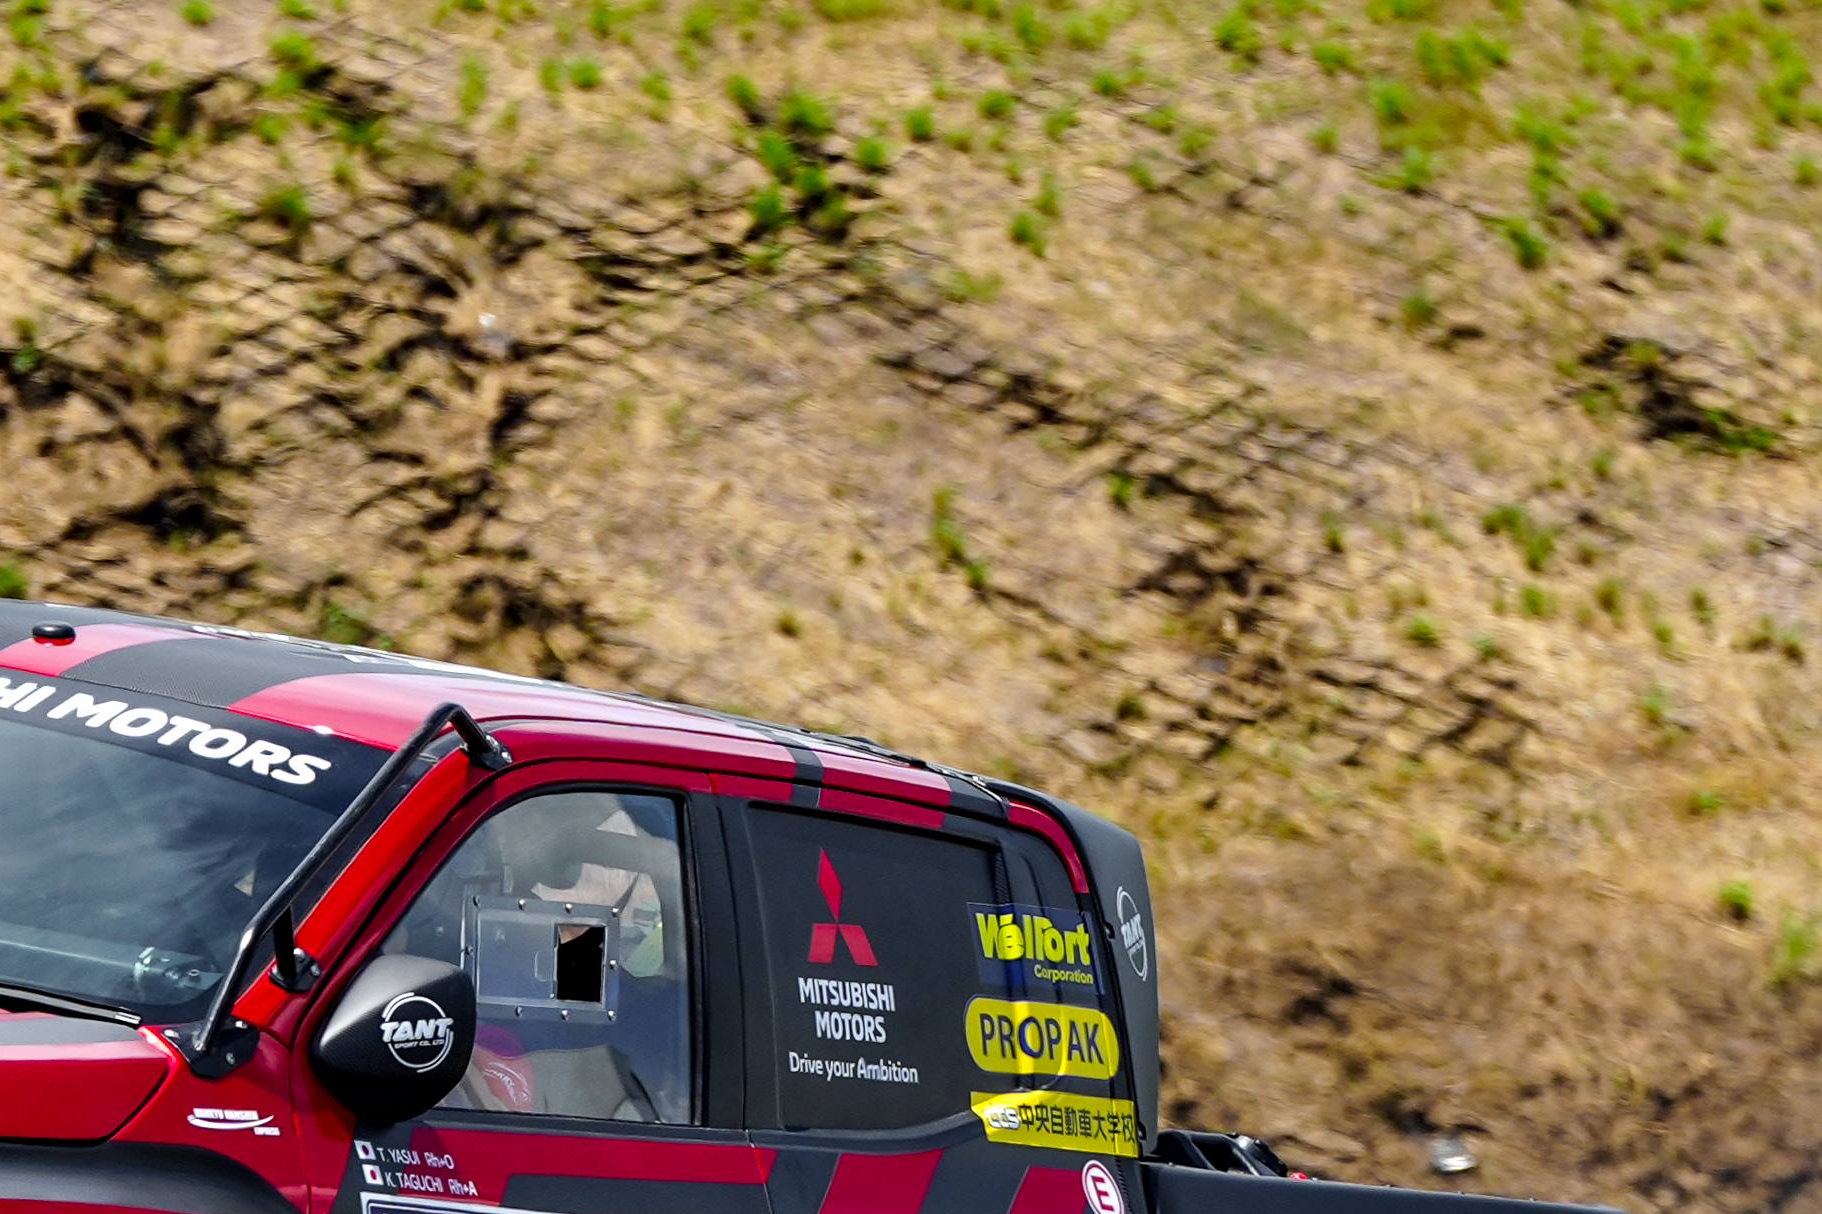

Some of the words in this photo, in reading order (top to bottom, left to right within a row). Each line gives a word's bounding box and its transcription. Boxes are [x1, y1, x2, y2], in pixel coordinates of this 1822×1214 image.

[48, 692, 331, 785] MOTORS
[1034, 963, 1094, 985] Corporation
[798, 978, 896, 1012] MITSUBISHI
[380, 1017, 454, 1043] TANT
[816, 1011, 887, 1043] MOTORS
[980, 1013, 1105, 1065] PROPAK
[789, 1052, 823, 1076] Drive
[825, 1060, 855, 1081] your
[857, 1057, 919, 1083] Ambition
[1018, 1102, 1135, 1144] 中央自動車大学校
